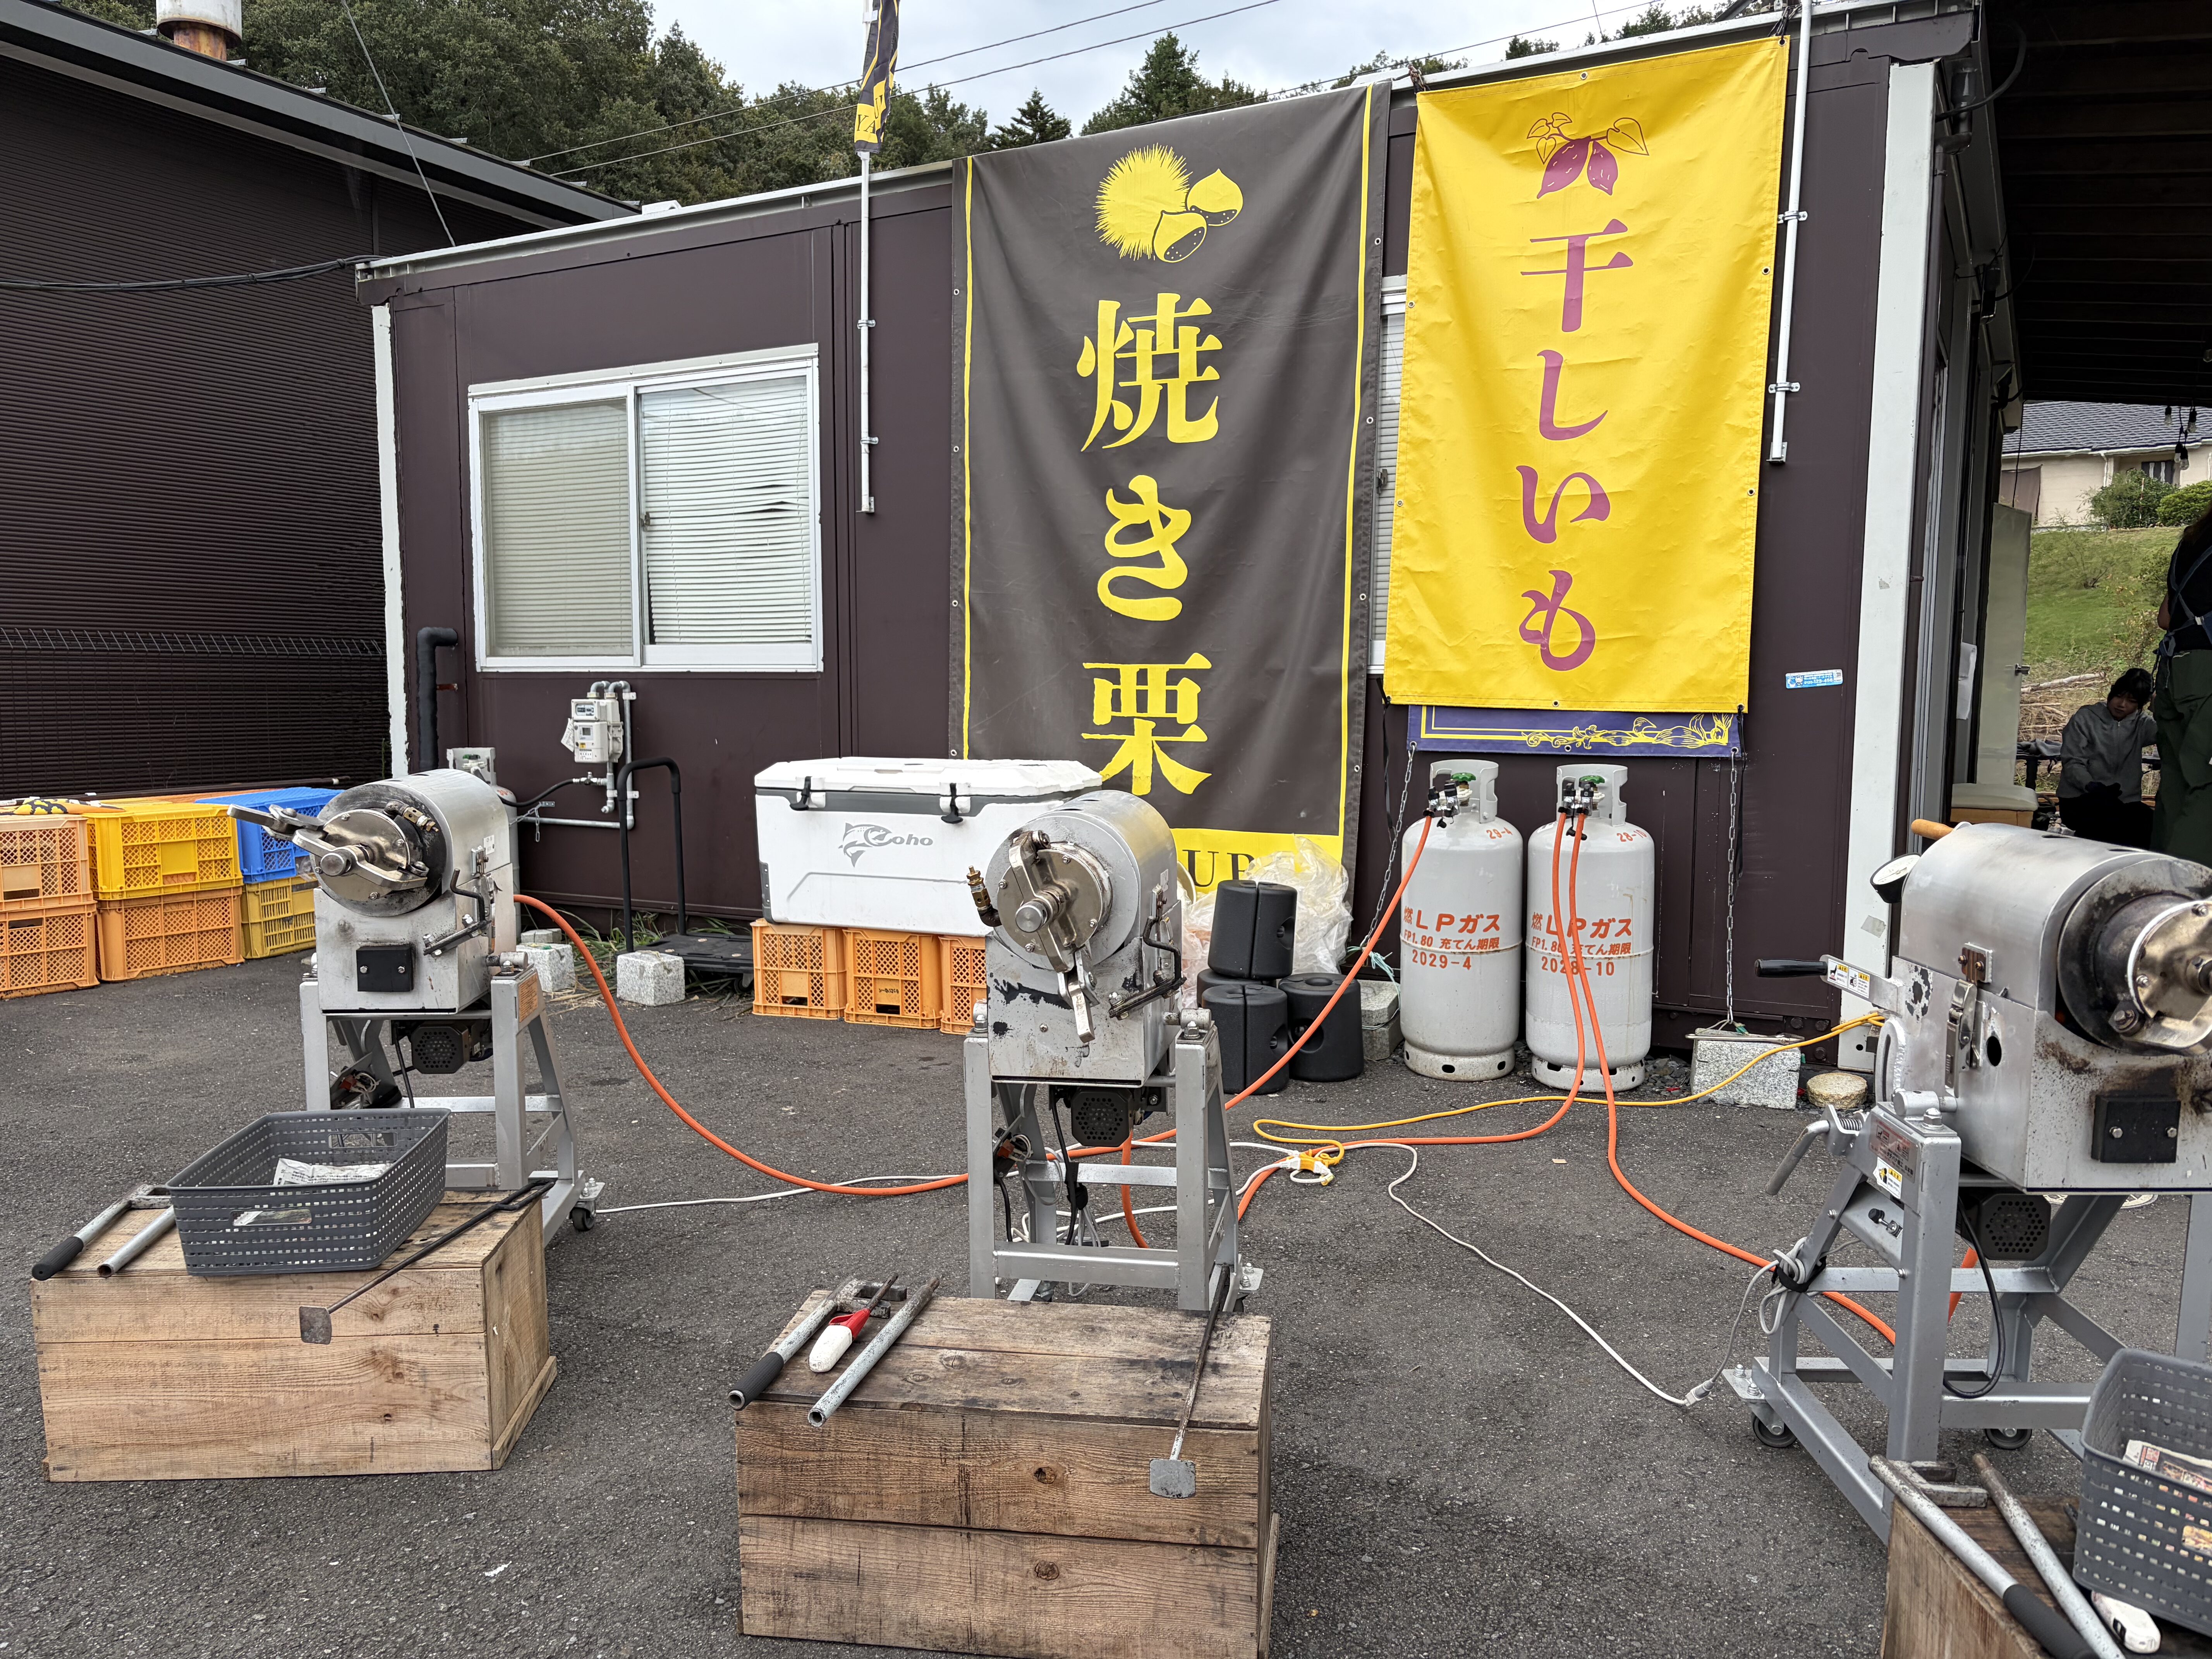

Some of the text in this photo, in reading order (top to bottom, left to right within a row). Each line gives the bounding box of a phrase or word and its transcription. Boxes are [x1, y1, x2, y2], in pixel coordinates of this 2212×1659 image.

[1516, 218, 1633, 672] 干しいも
[1077, 292, 1223, 795] 焼き栗
[864, 826, 933, 847] Coho
[1486, 827, 1513, 840] 29-4
[1439, 937, 1500, 950] 充てん期限
[1412, 949, 1472, 970] 2029-4
